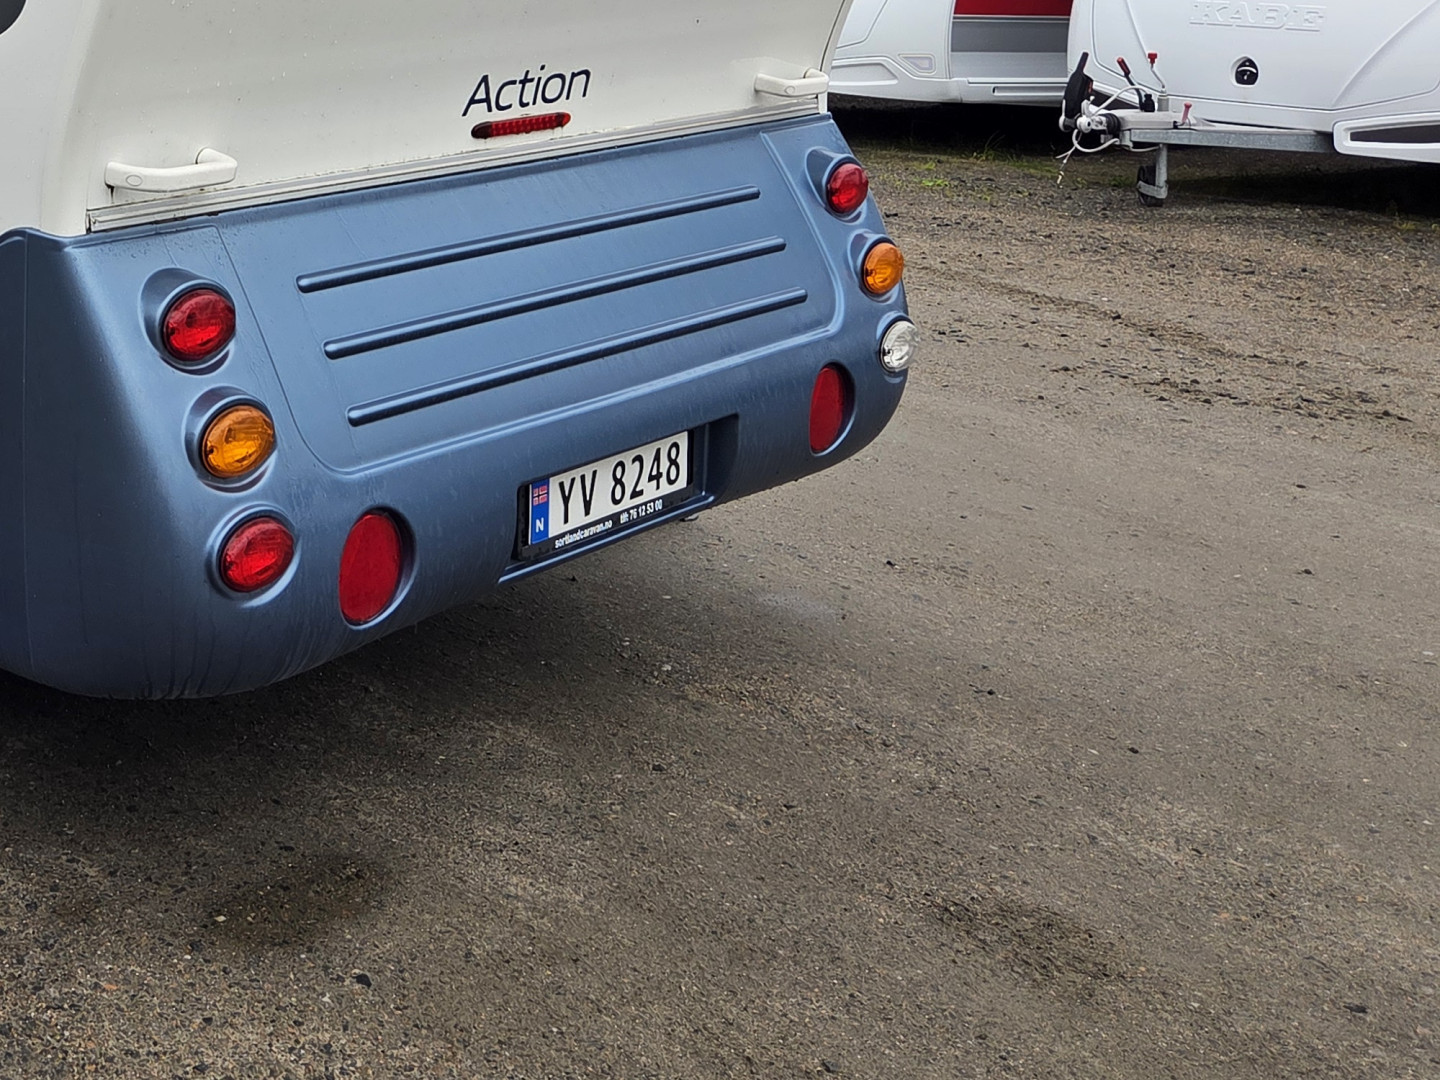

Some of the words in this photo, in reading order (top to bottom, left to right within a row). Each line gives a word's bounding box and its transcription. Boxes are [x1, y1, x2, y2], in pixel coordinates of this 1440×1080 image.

[1189, 0, 1328, 32] KABE
[461, 64, 592, 117] Action
[558, 469, 598, 525] YV
[610, 441, 681, 506] 8248
[535, 517, 545, 533] N
[554, 519, 613, 549] sortlandcaravan.no
[629, 508, 638, 521] 76
[638, 505, 646, 517] 12
[646, 502, 654, 514] 53
[655, 499, 663, 511] 00
